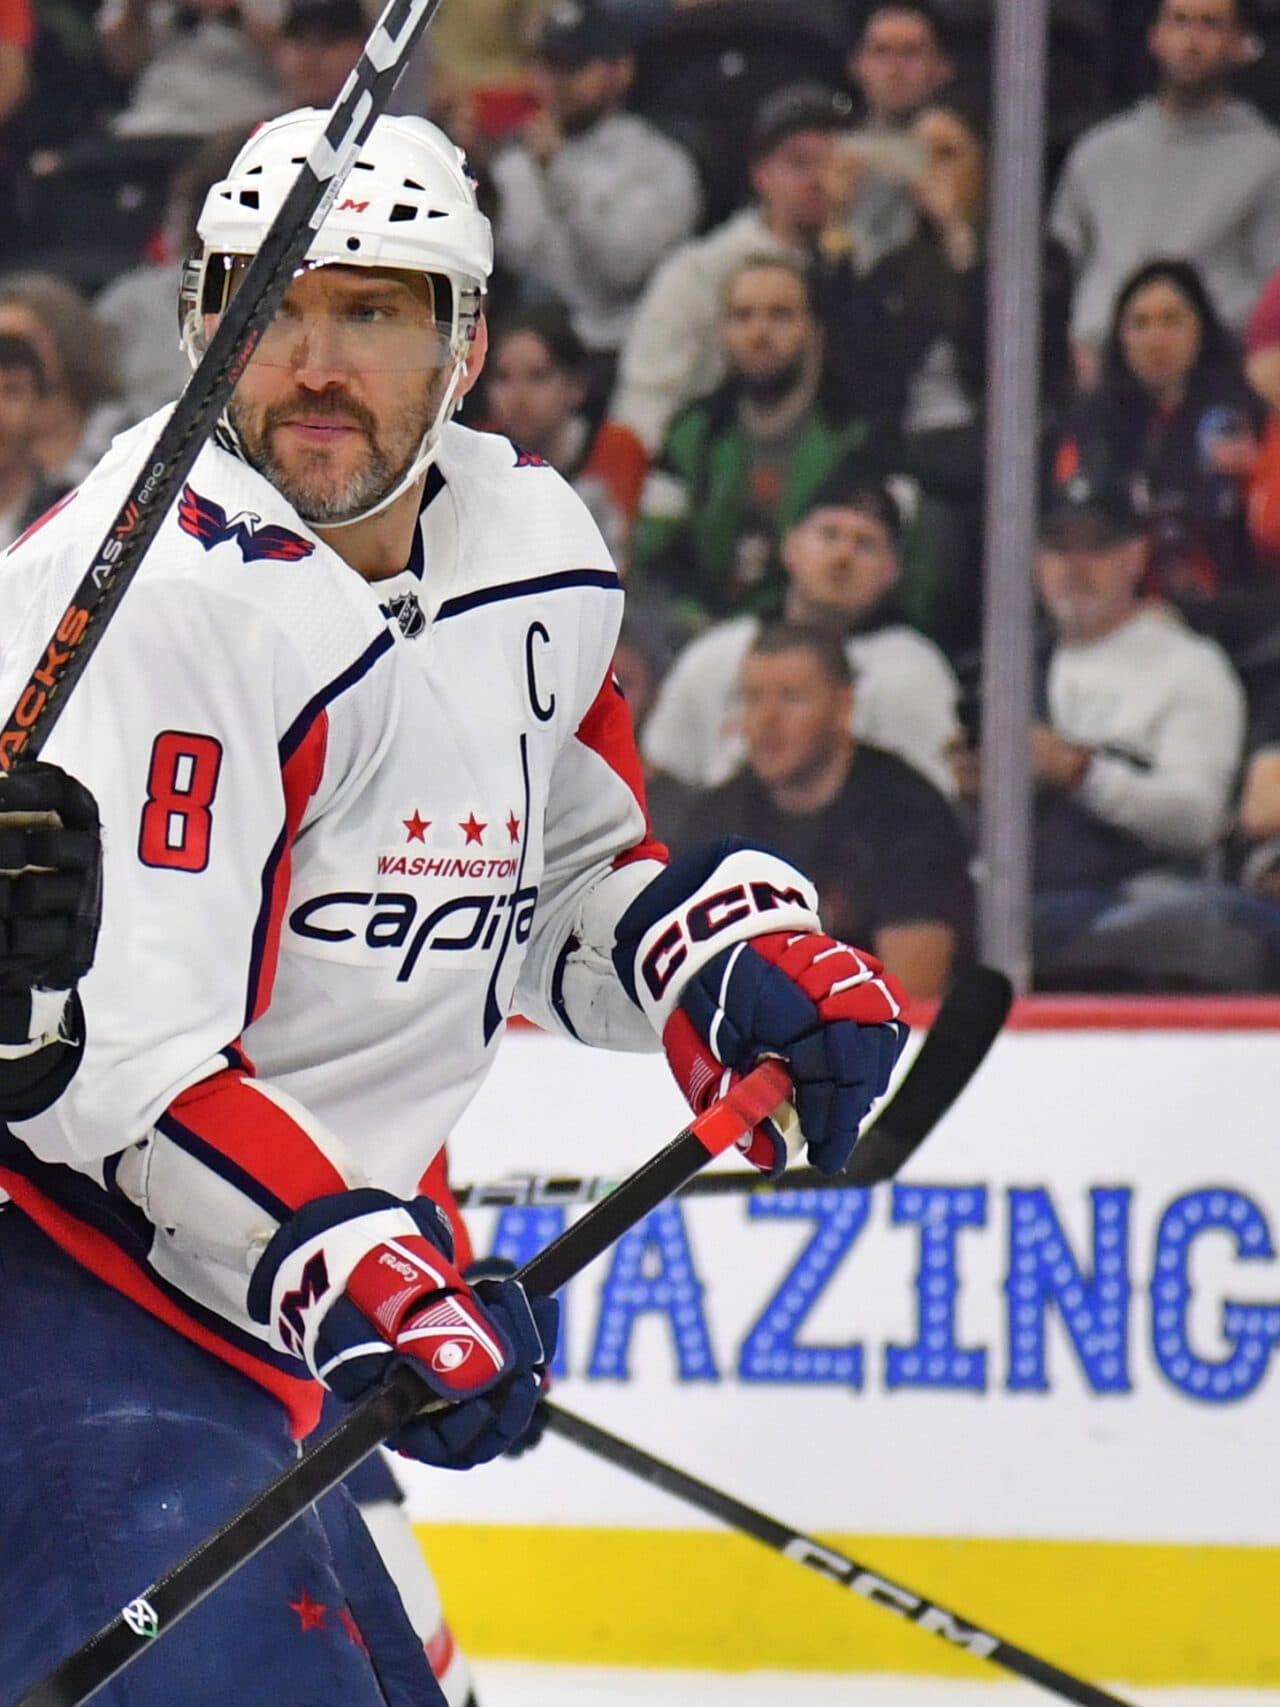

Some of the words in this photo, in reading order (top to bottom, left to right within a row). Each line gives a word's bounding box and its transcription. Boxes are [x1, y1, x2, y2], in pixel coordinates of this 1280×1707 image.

[138, 462, 165, 505] PRO
[526, 620, 555, 722] C
[137, 730, 223, 873] 8
[377, 855, 518, 879] WASHINGTON
[641, 881, 811, 1002] CCM
[783, 1537, 1001, 1658] CCM
